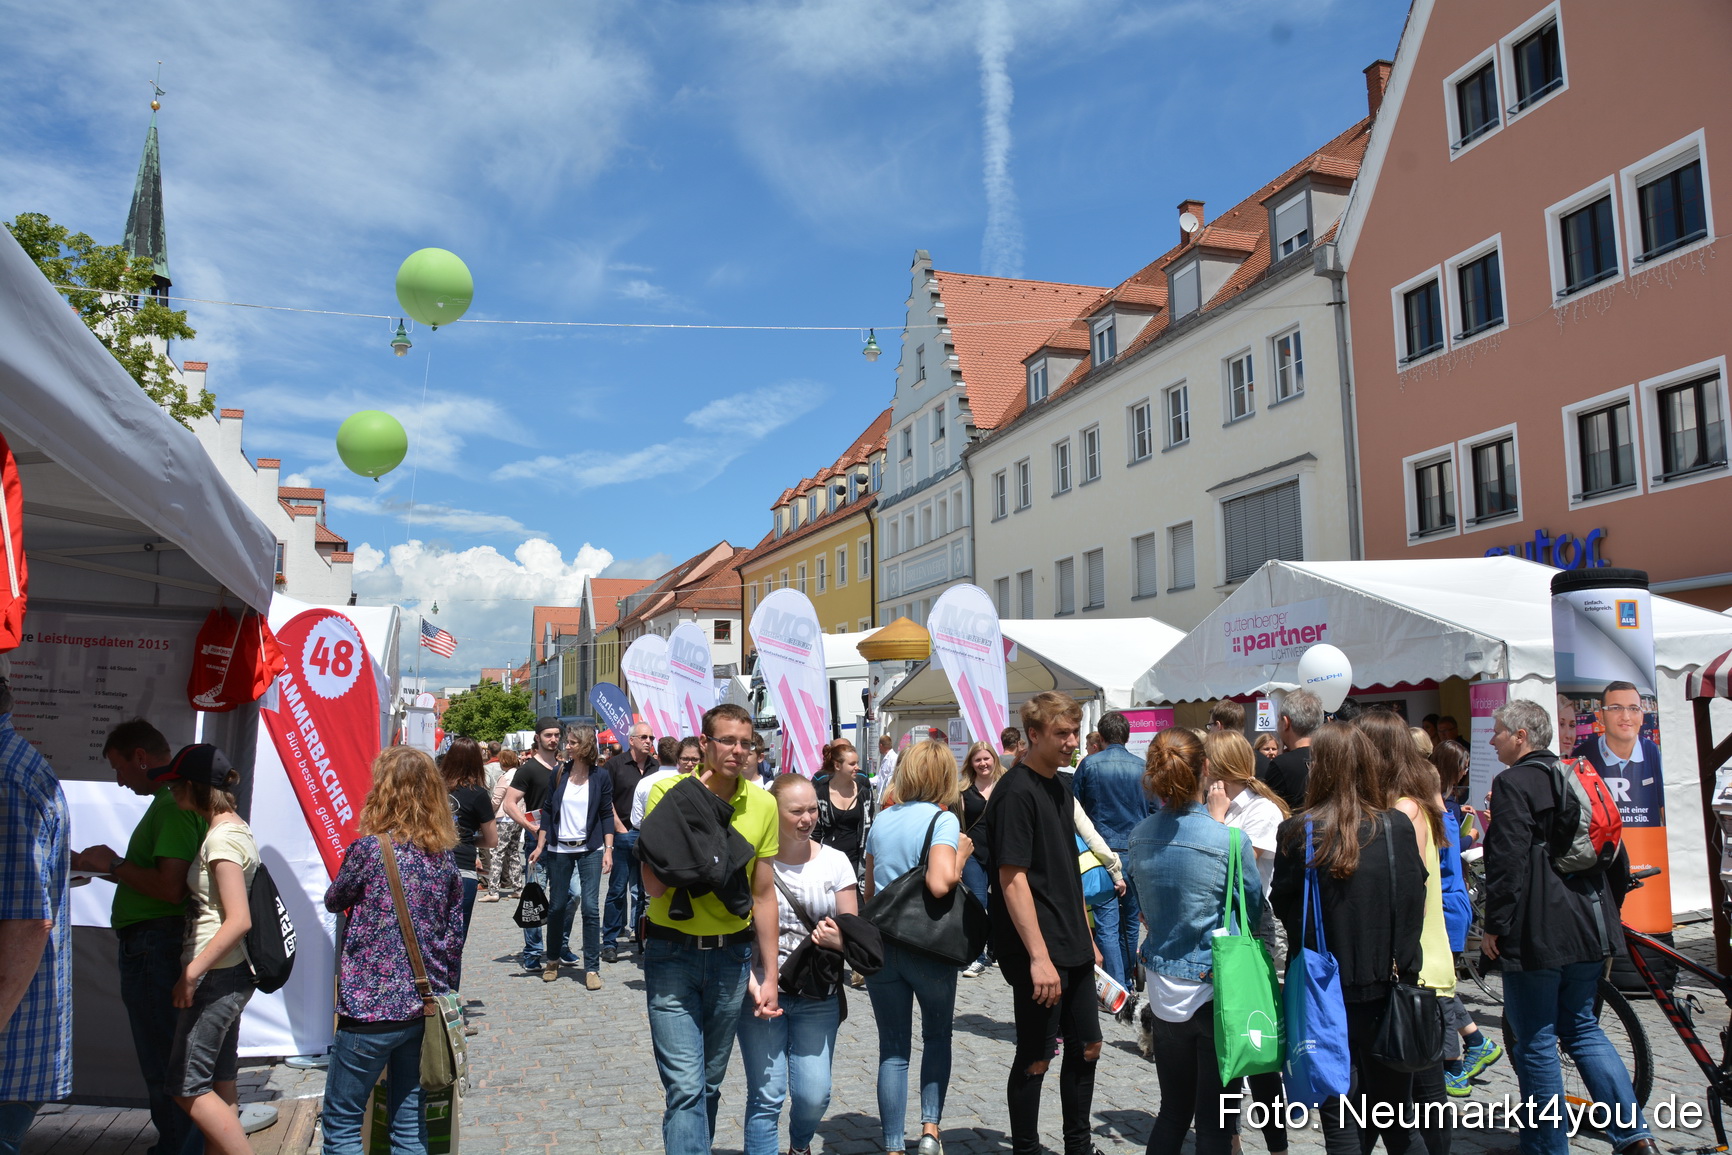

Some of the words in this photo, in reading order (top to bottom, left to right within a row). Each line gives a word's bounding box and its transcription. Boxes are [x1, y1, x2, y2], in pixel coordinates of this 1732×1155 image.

[1223, 611, 1288, 637] guttenberger
[37, 632, 134, 648] Leistungsdaten
[137, 638, 169, 650] 2015
[309, 636, 354, 678] 48
[1307, 672, 1343, 684] DELPHI
[1156, 718, 1170, 727] ein.
[1259, 716, 1270, 727] 36
[278, 655, 354, 827] AMMERBACHER
[286, 731, 302, 759] Büro
[315, 805, 346, 858] geliefert.
[1622, 815, 1633, 823] LDI
[1634, 813, 1649, 823] SÜD.
